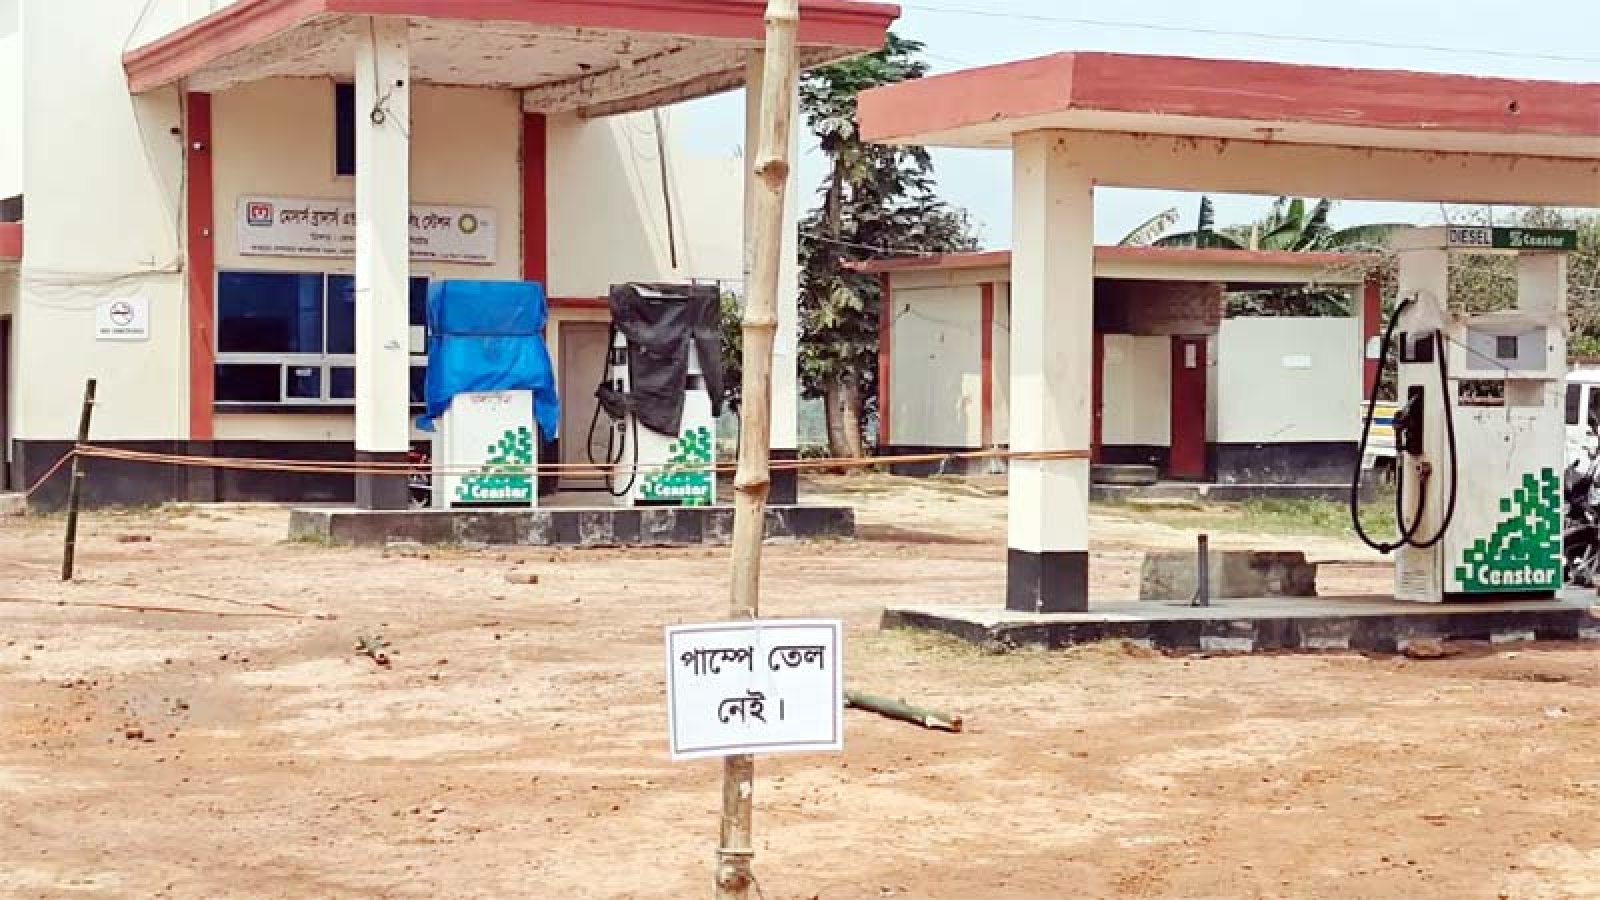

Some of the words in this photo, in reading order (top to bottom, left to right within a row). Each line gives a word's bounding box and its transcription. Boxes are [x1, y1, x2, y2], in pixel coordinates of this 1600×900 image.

[1450, 229, 1490, 245] DIESEL
[472, 483, 529, 499] Censtar
[654, 483, 708, 498] Censtar
[1478, 564, 1556, 585] Censtar
[680, 646, 754, 675] পাম্পে
[768, 645, 826, 671] তেল
[718, 688, 767, 723] নেই
